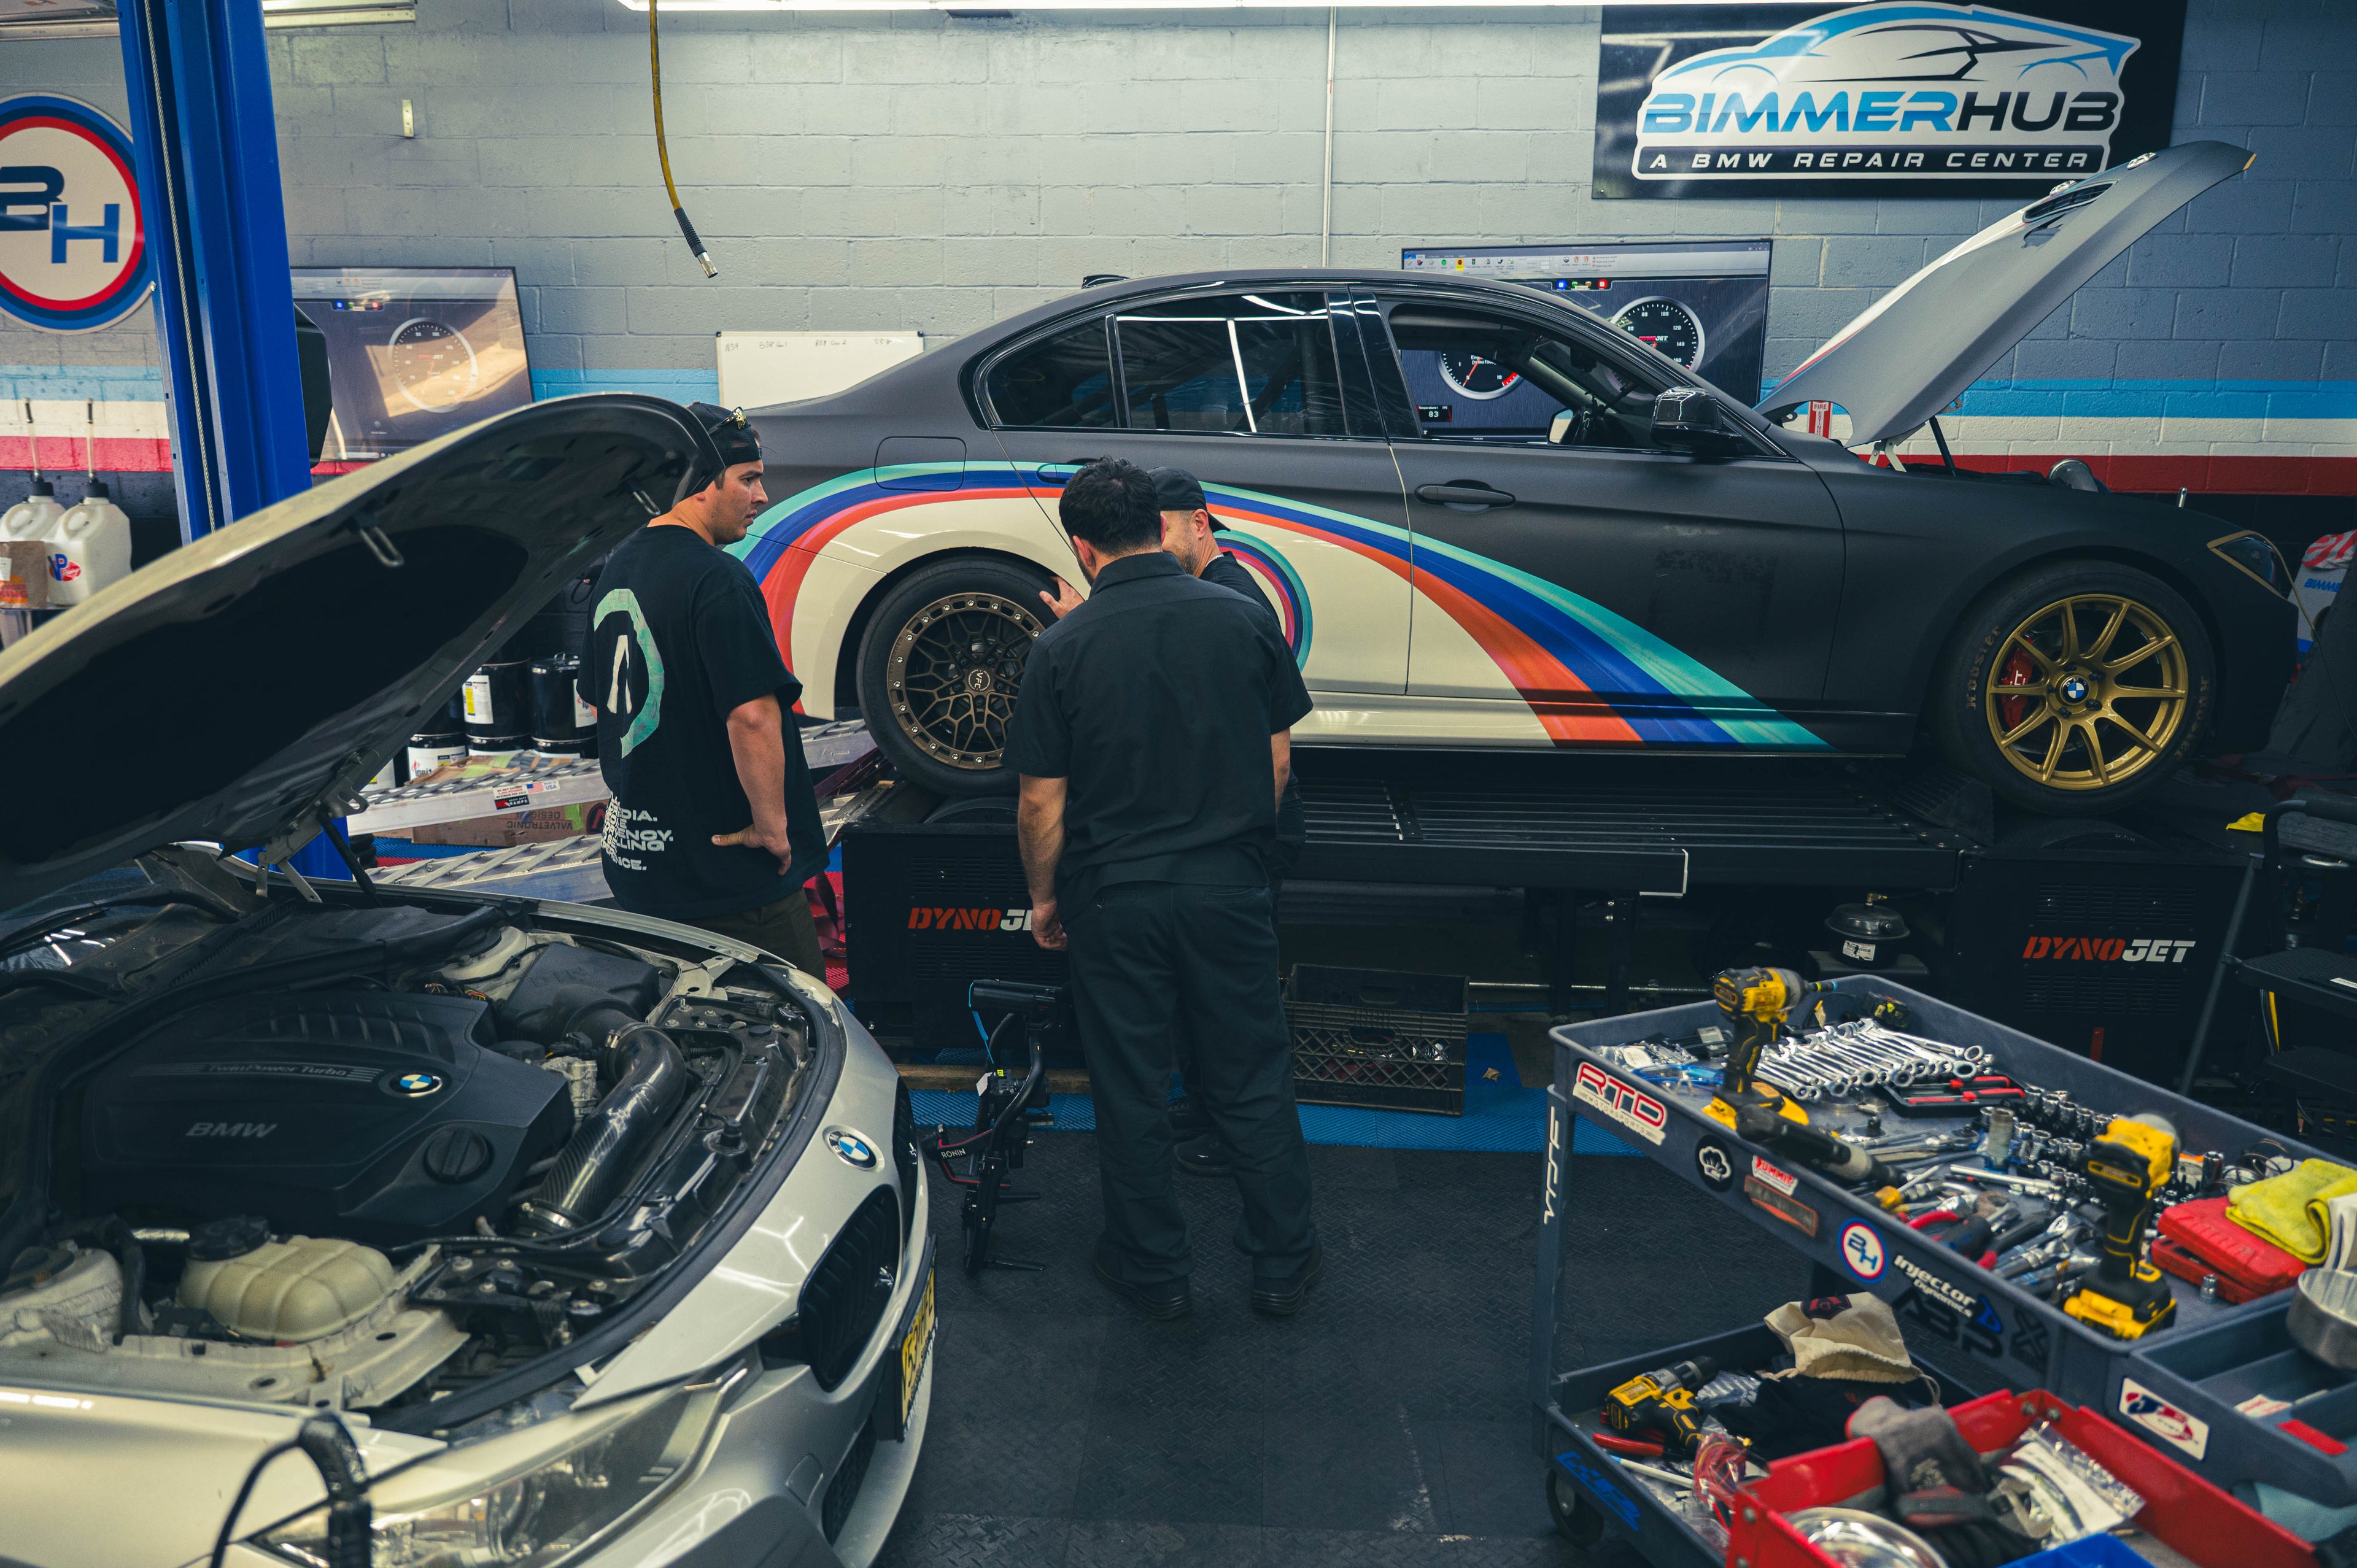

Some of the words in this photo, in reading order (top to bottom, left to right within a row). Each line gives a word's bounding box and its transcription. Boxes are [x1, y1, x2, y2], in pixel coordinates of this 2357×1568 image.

[1642, 90, 2120, 134] BIMMERHUB
[1649, 153, 1668, 169] A
[1692, 152, 1775, 169] BMW
[1794, 151, 1925, 169] REPAIR
[1946, 151, 2089, 169] CENTER
[47, 553, 69, 581] VP
[506, 821, 573, 830] VALVETRONIC
[907, 907, 1032, 932] DYNOJ
[2022, 936, 2196, 964] DYNOJET
[301, 1065, 347, 1077] Turbo
[1578, 1063, 1665, 1127] RTD
[1588, 1095, 1645, 1134] MOTORSPORTS
[185, 1121, 279, 1138] BMW
[940, 1147, 967, 1159] RONIN
[1894, 1254, 1978, 1307] Injector
